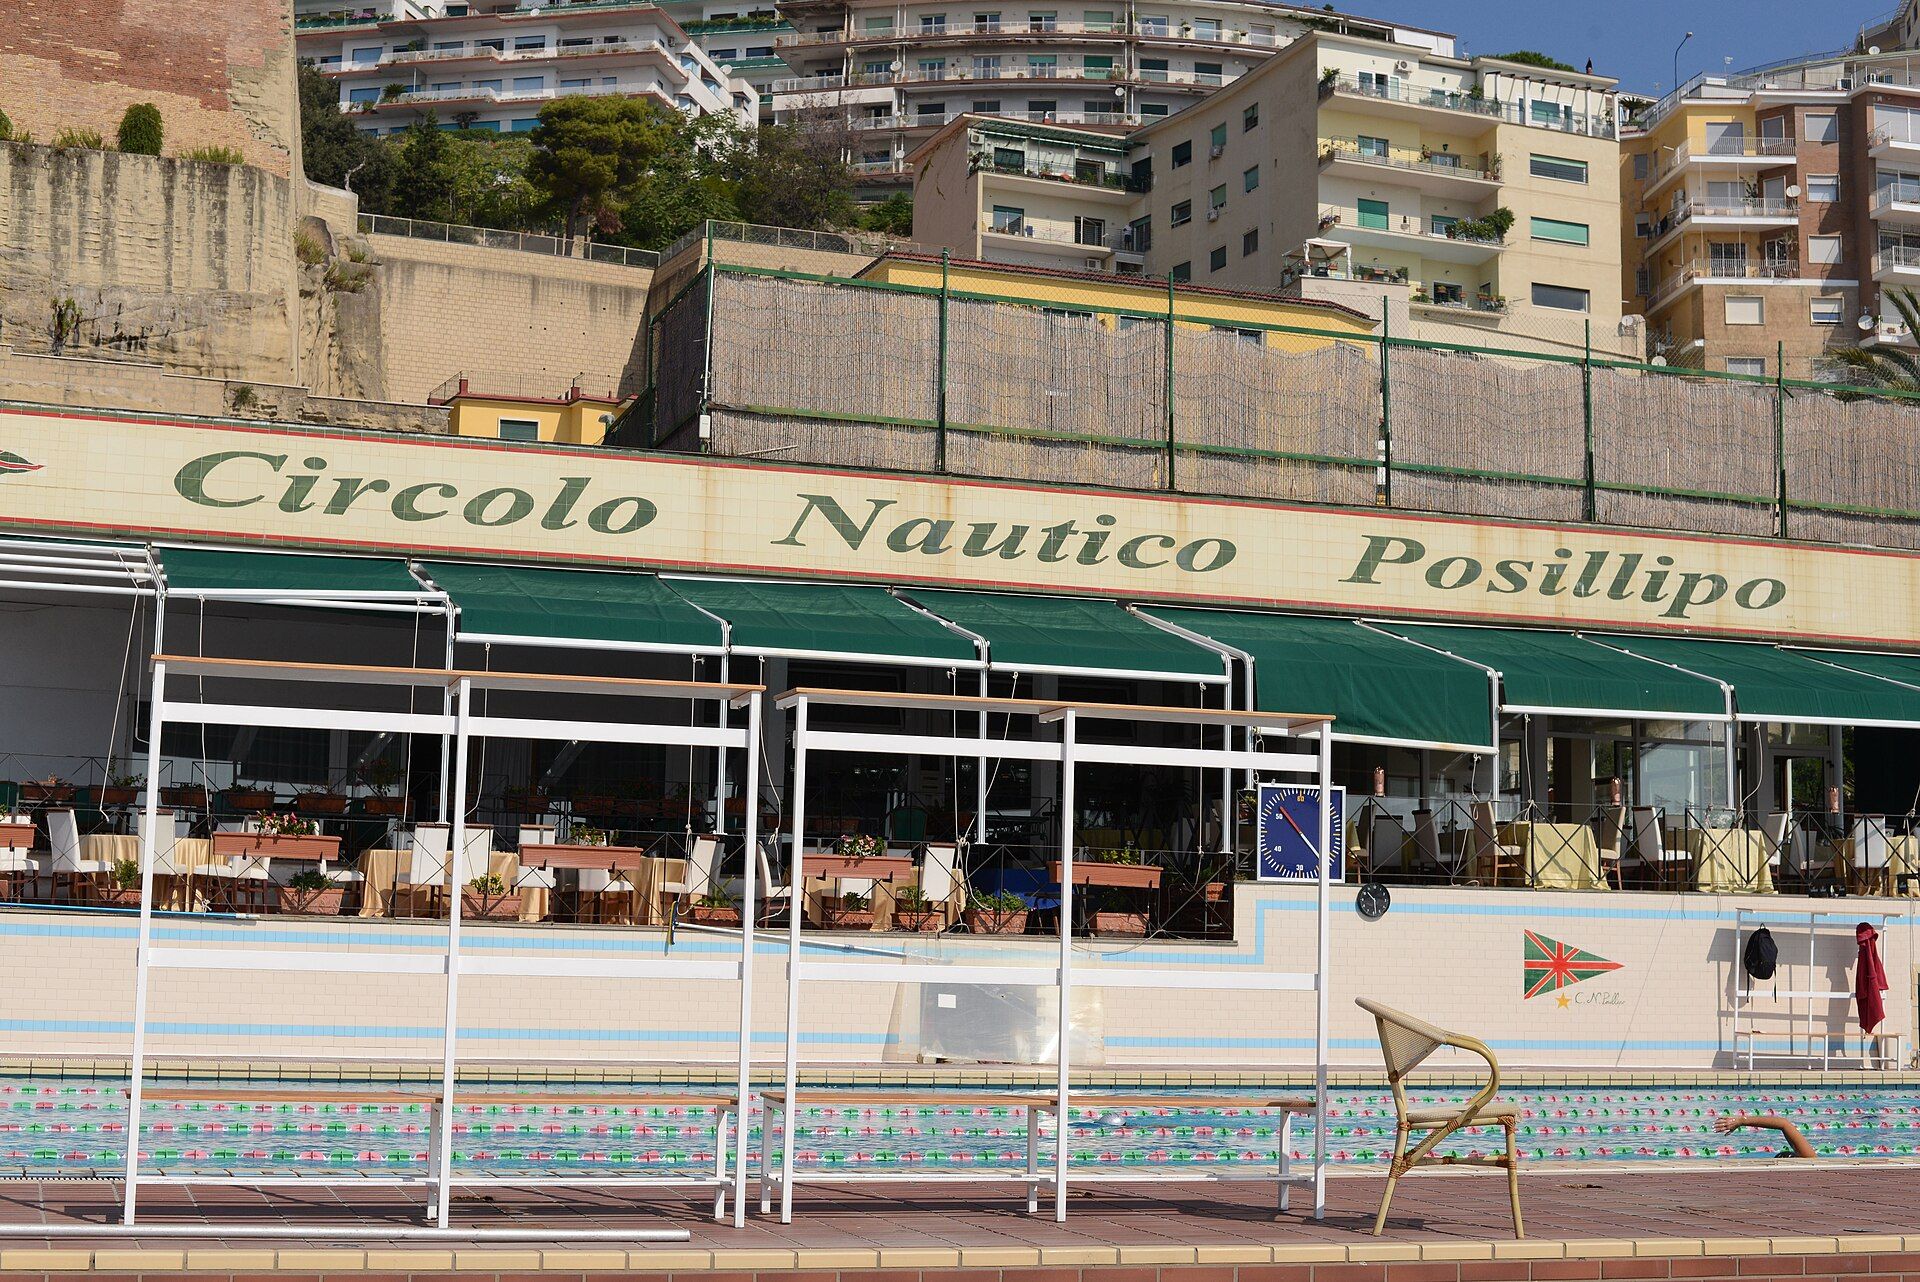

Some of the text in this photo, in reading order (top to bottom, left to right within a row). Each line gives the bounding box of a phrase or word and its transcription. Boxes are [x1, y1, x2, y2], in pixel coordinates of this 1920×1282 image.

[174, 451, 1787, 618] Circolo Nautico Posillipo
